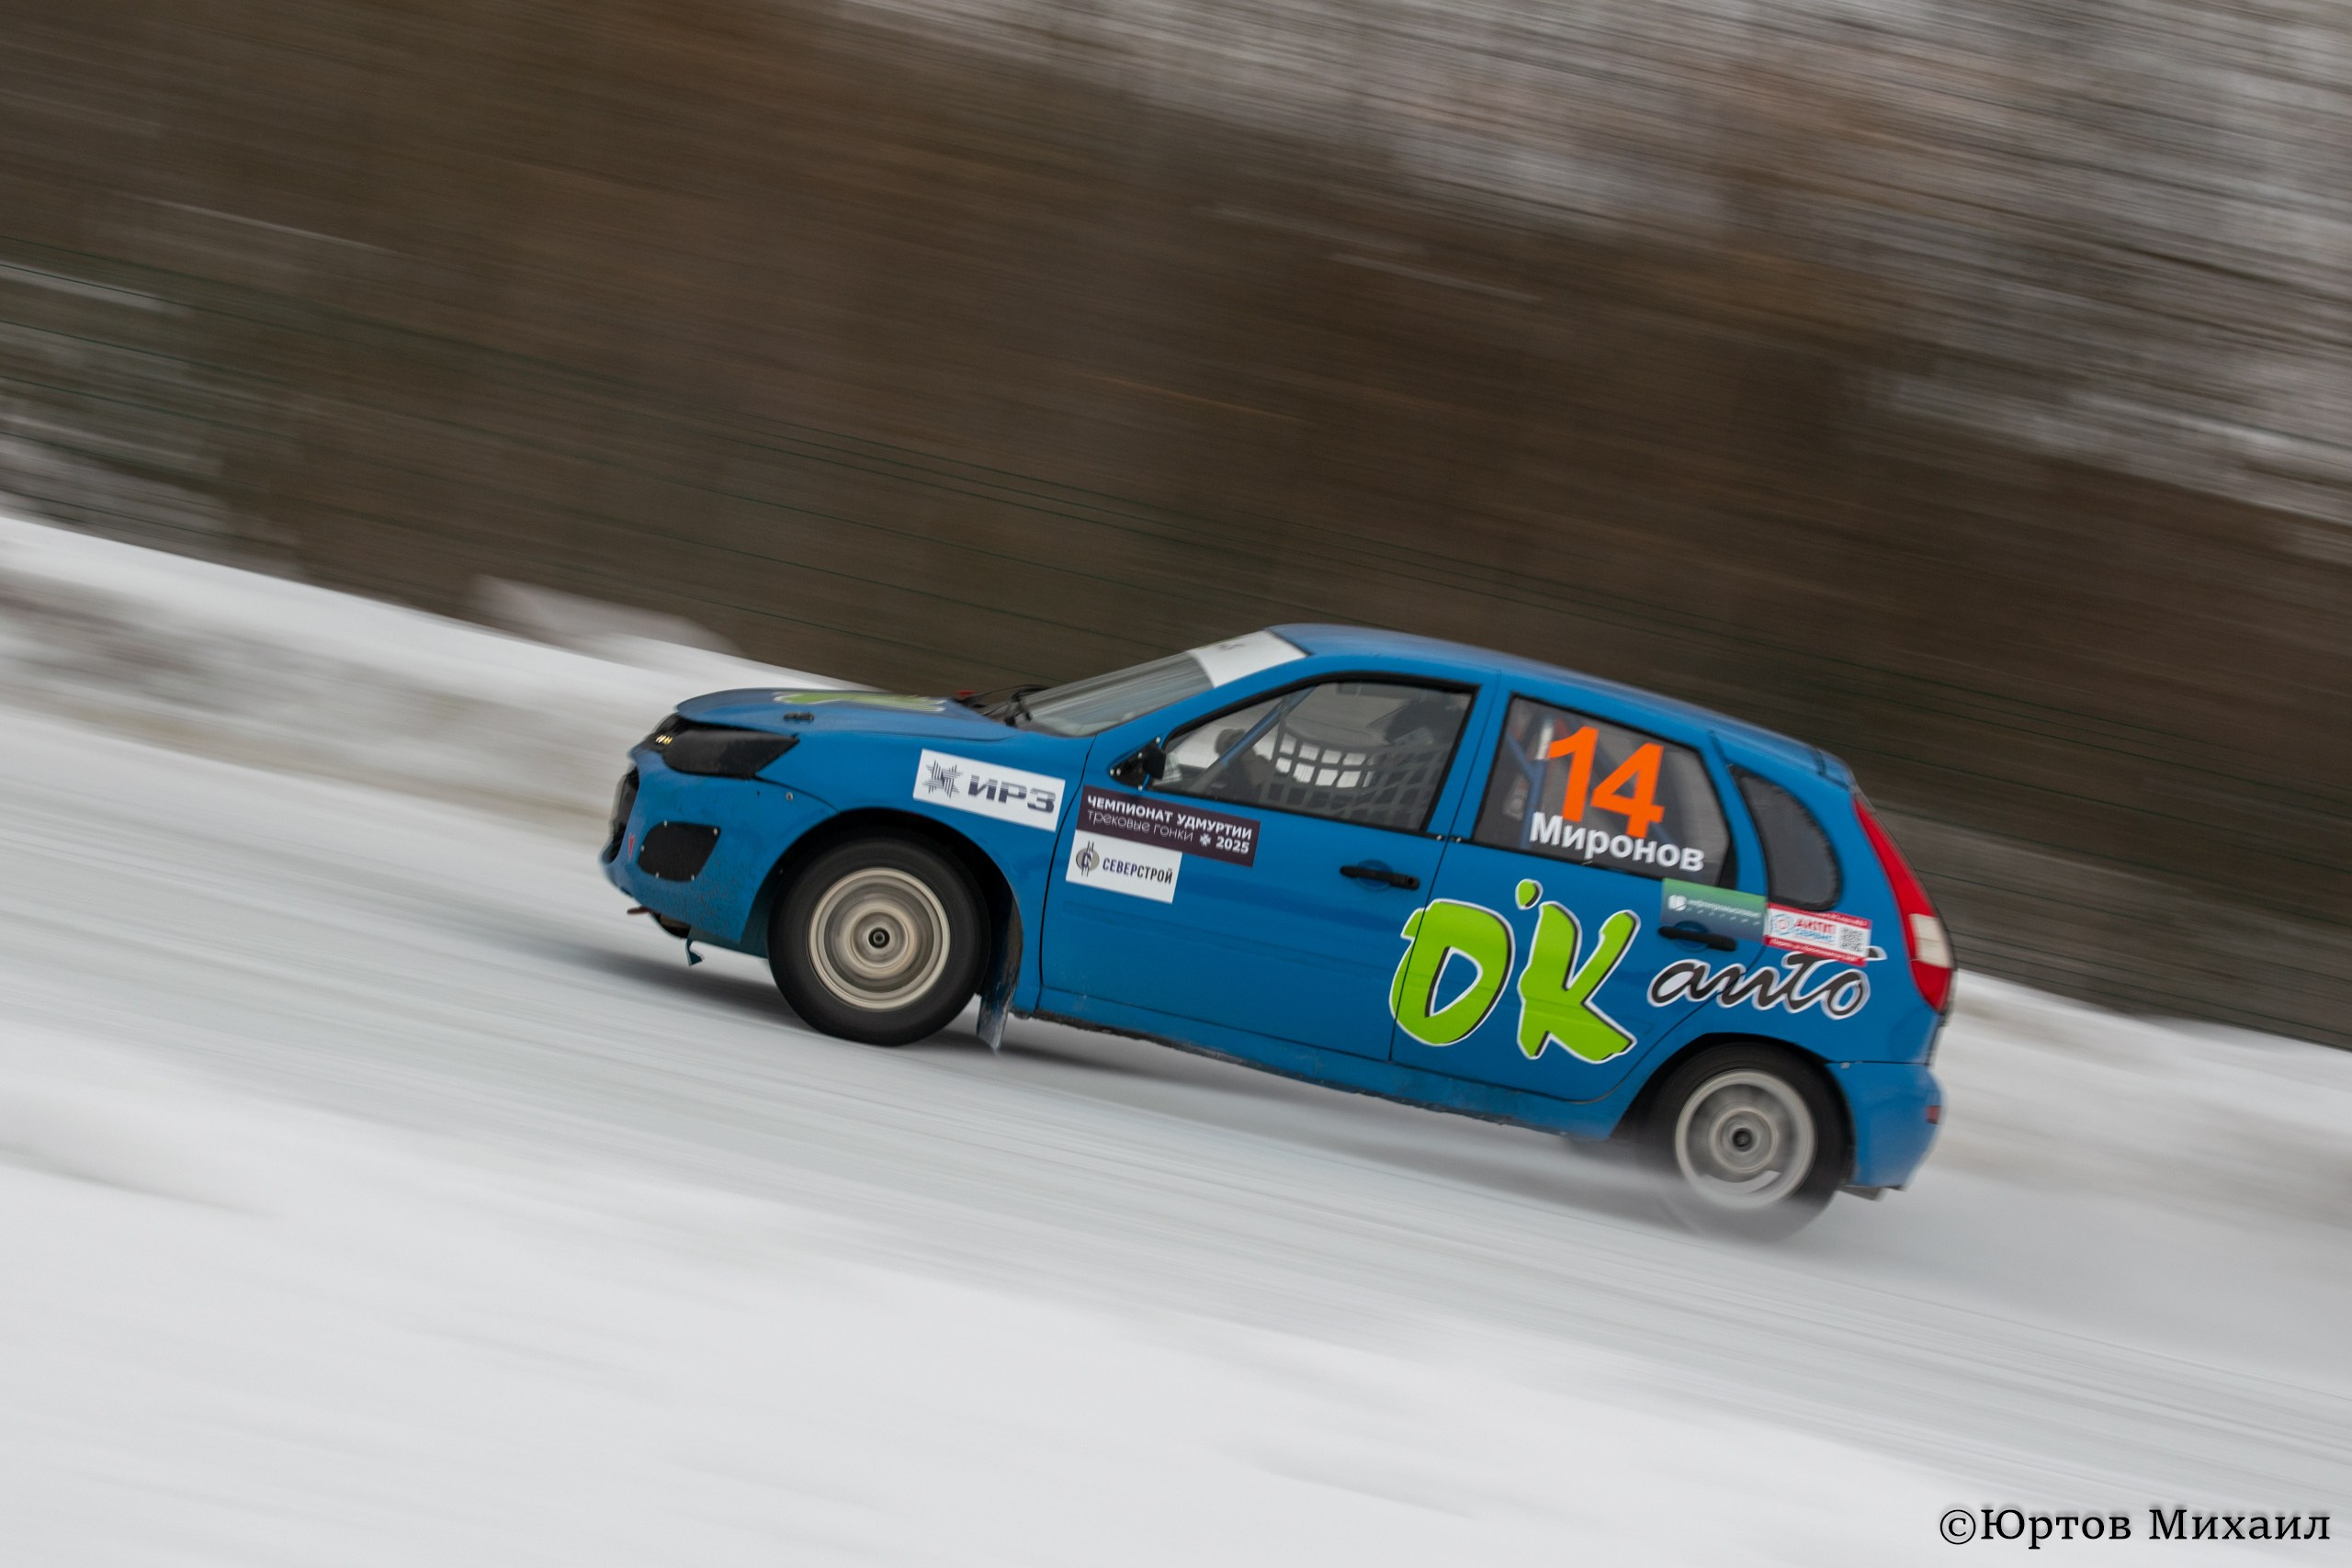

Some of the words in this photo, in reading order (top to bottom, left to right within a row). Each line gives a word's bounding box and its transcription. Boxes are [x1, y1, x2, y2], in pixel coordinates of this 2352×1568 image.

[967, 774, 1057, 814] ИРЗ
[1547, 726, 1665, 839] 14
[1087, 795, 1173, 823] ЧЕМПИОНАТ
[1177, 814, 1252, 840] УДМУРТИИ
[1153, 824, 1193, 842] гонки
[1216, 835, 1250, 854] 2025
[1530, 811, 1705, 873] Миронов
[1102, 856, 1173, 885] СЕВЕРСТРОЙ
